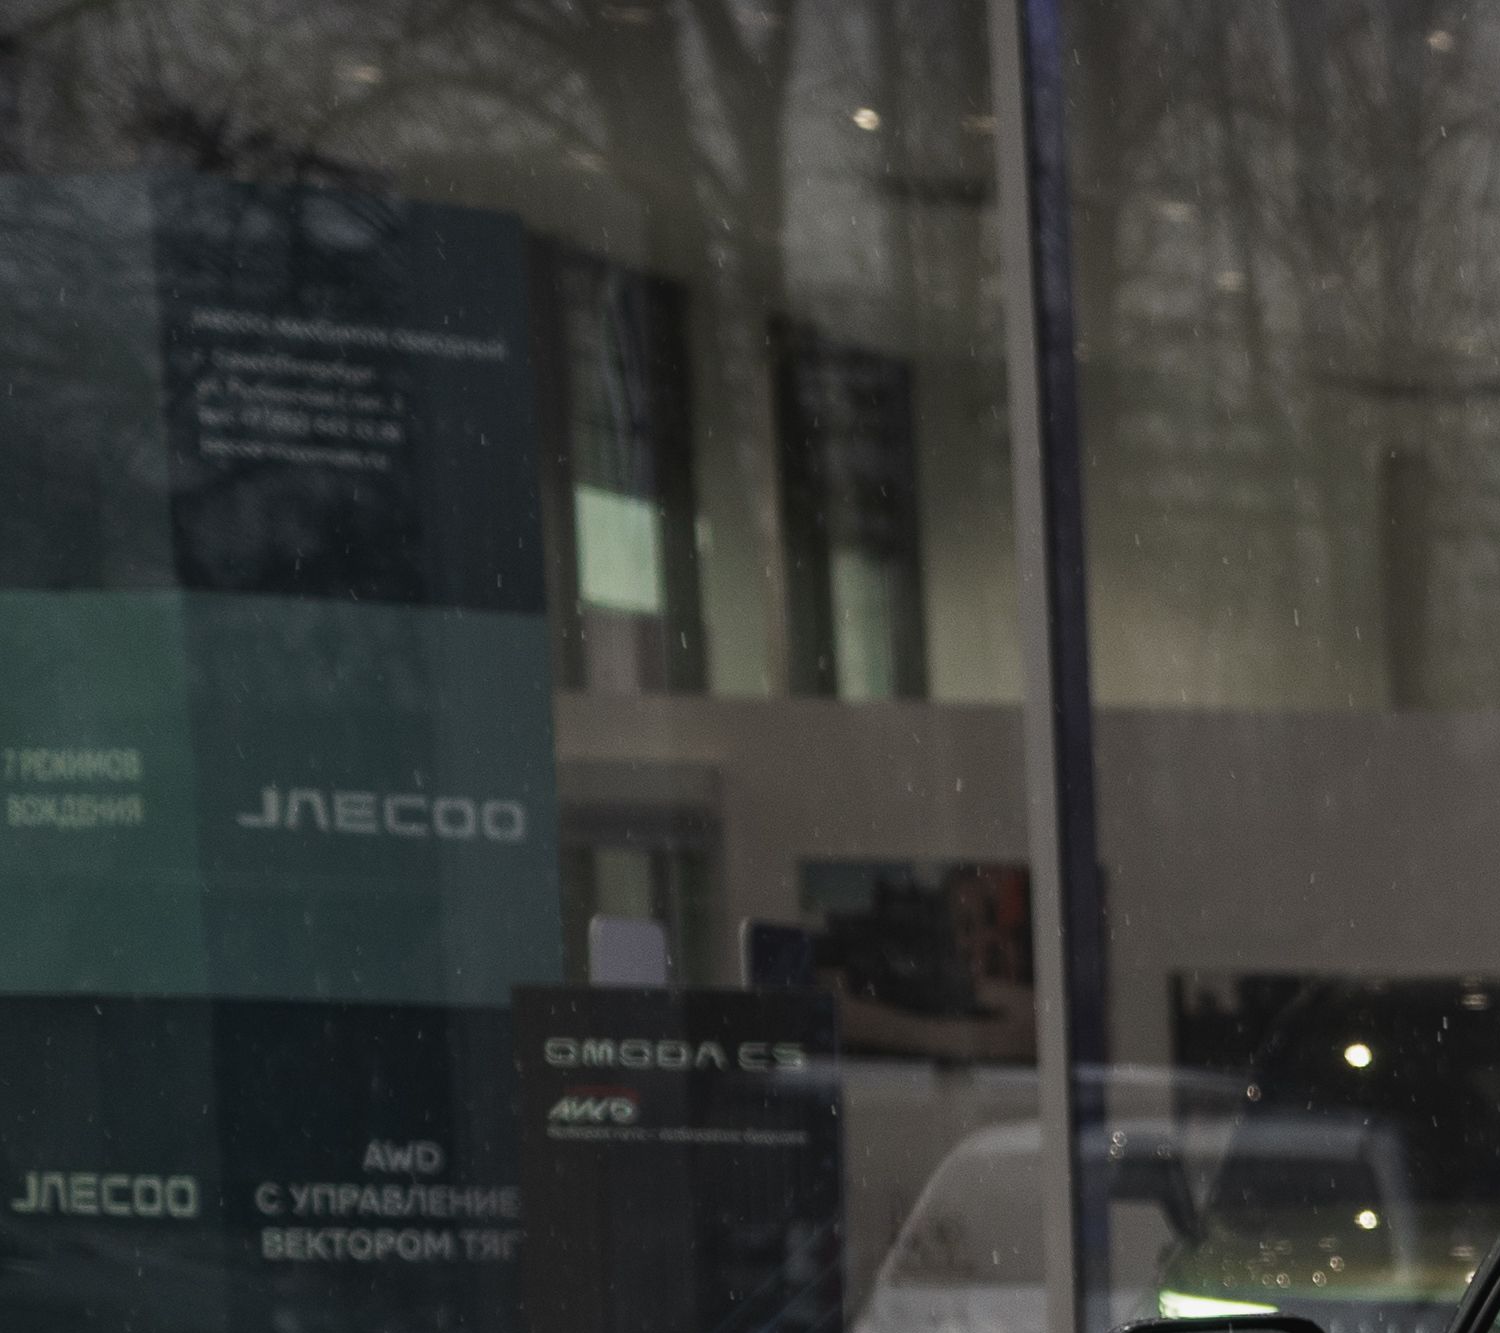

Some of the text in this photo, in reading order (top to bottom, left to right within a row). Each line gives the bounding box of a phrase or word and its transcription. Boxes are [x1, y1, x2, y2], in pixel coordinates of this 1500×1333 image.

[236, 787, 527, 842] JAECOO
[362, 1139, 444, 1173] AWD
[10, 1172, 198, 1217] JAECOO
[254, 1182, 520, 1217] С УПРАВЛЕНИЕ
[261, 1228, 520, 1261] ВЕКТОРОМ ТЯГ
